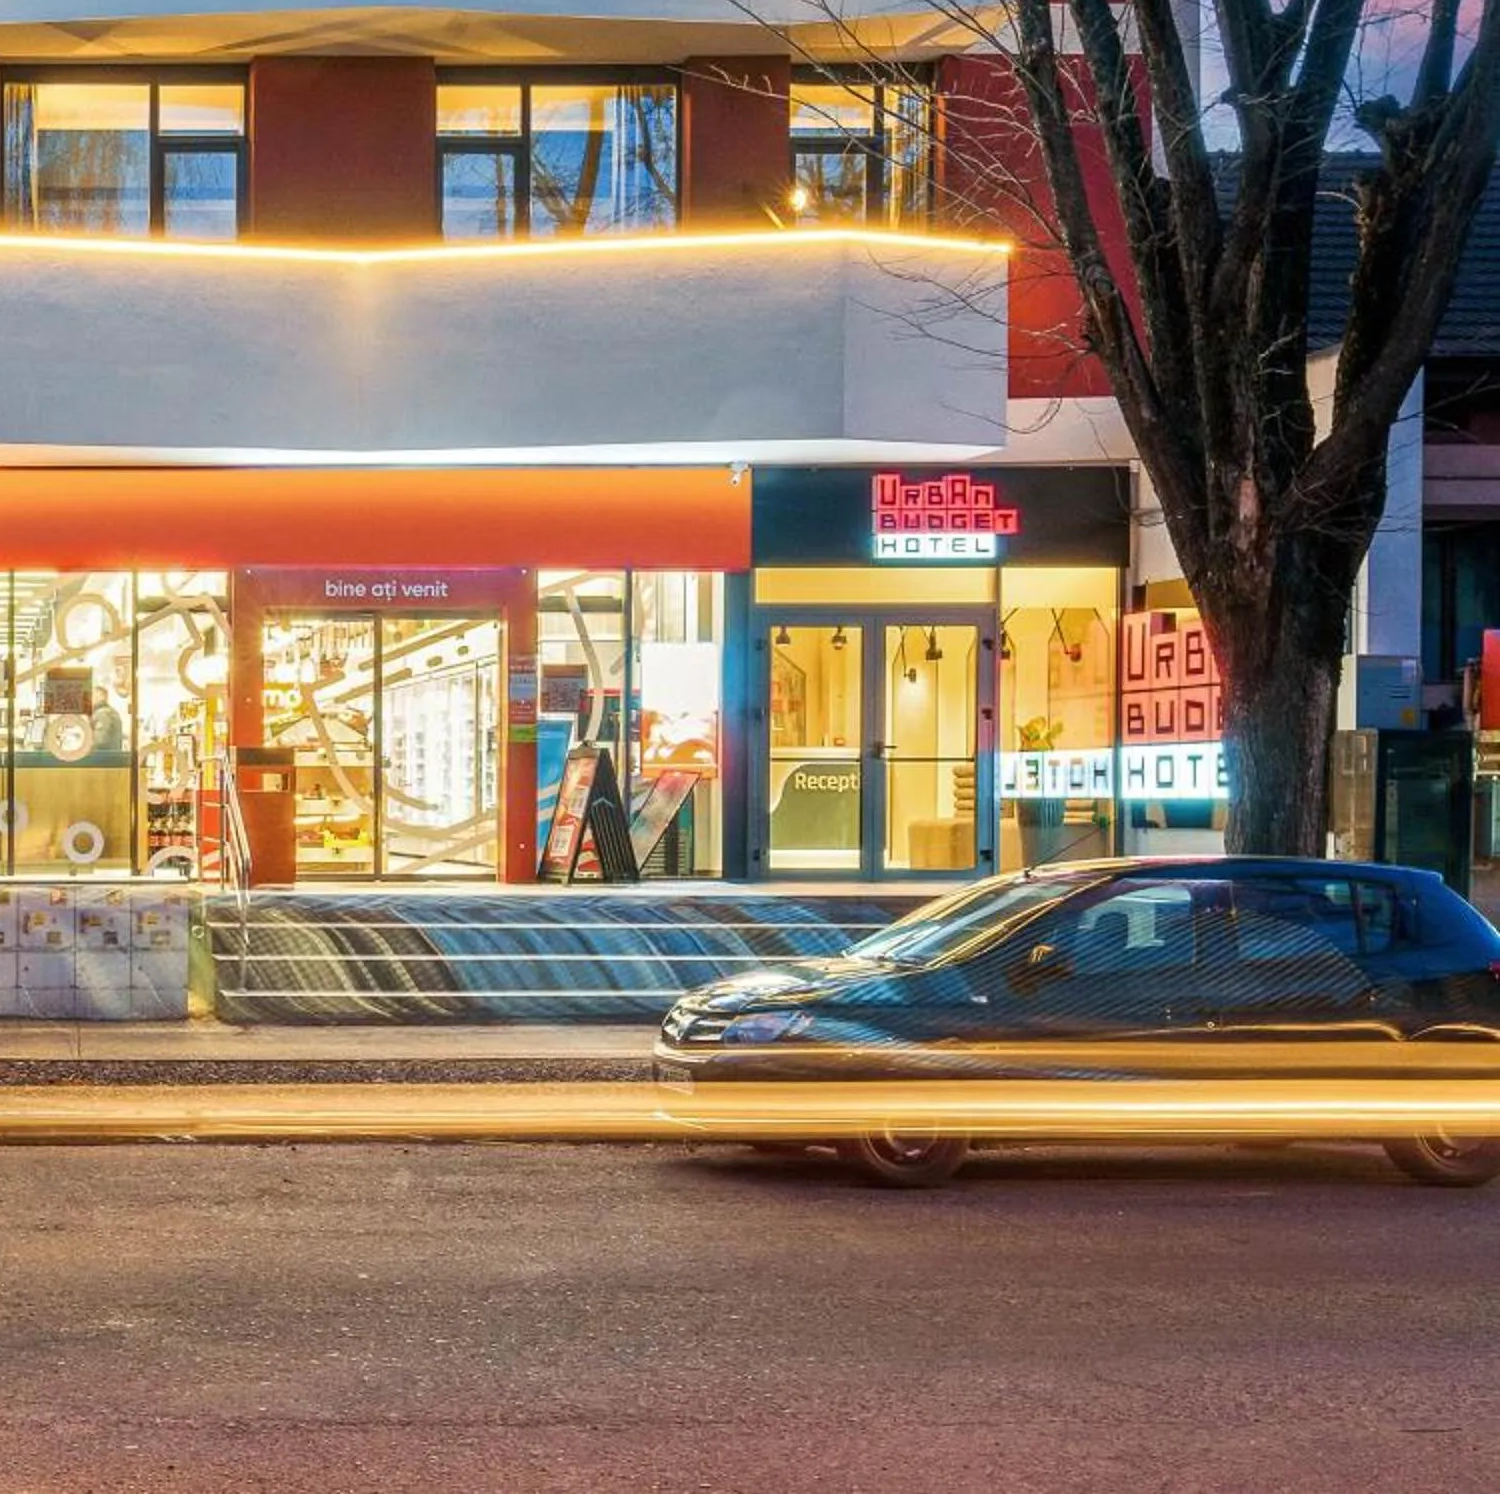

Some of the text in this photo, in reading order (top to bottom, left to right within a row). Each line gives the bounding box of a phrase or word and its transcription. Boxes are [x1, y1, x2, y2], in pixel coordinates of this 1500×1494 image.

[879, 512, 1014, 530] BUDGET
[881, 537, 991, 553] HOTEL
[325, 579, 366, 597] bine
[401, 580, 449, 597] venit
[1126, 621, 1205, 682] URB
[1126, 695, 1224, 735] BUD
[1126, 752, 1230, 789] HOTE
[795, 773, 860, 793] Recept
